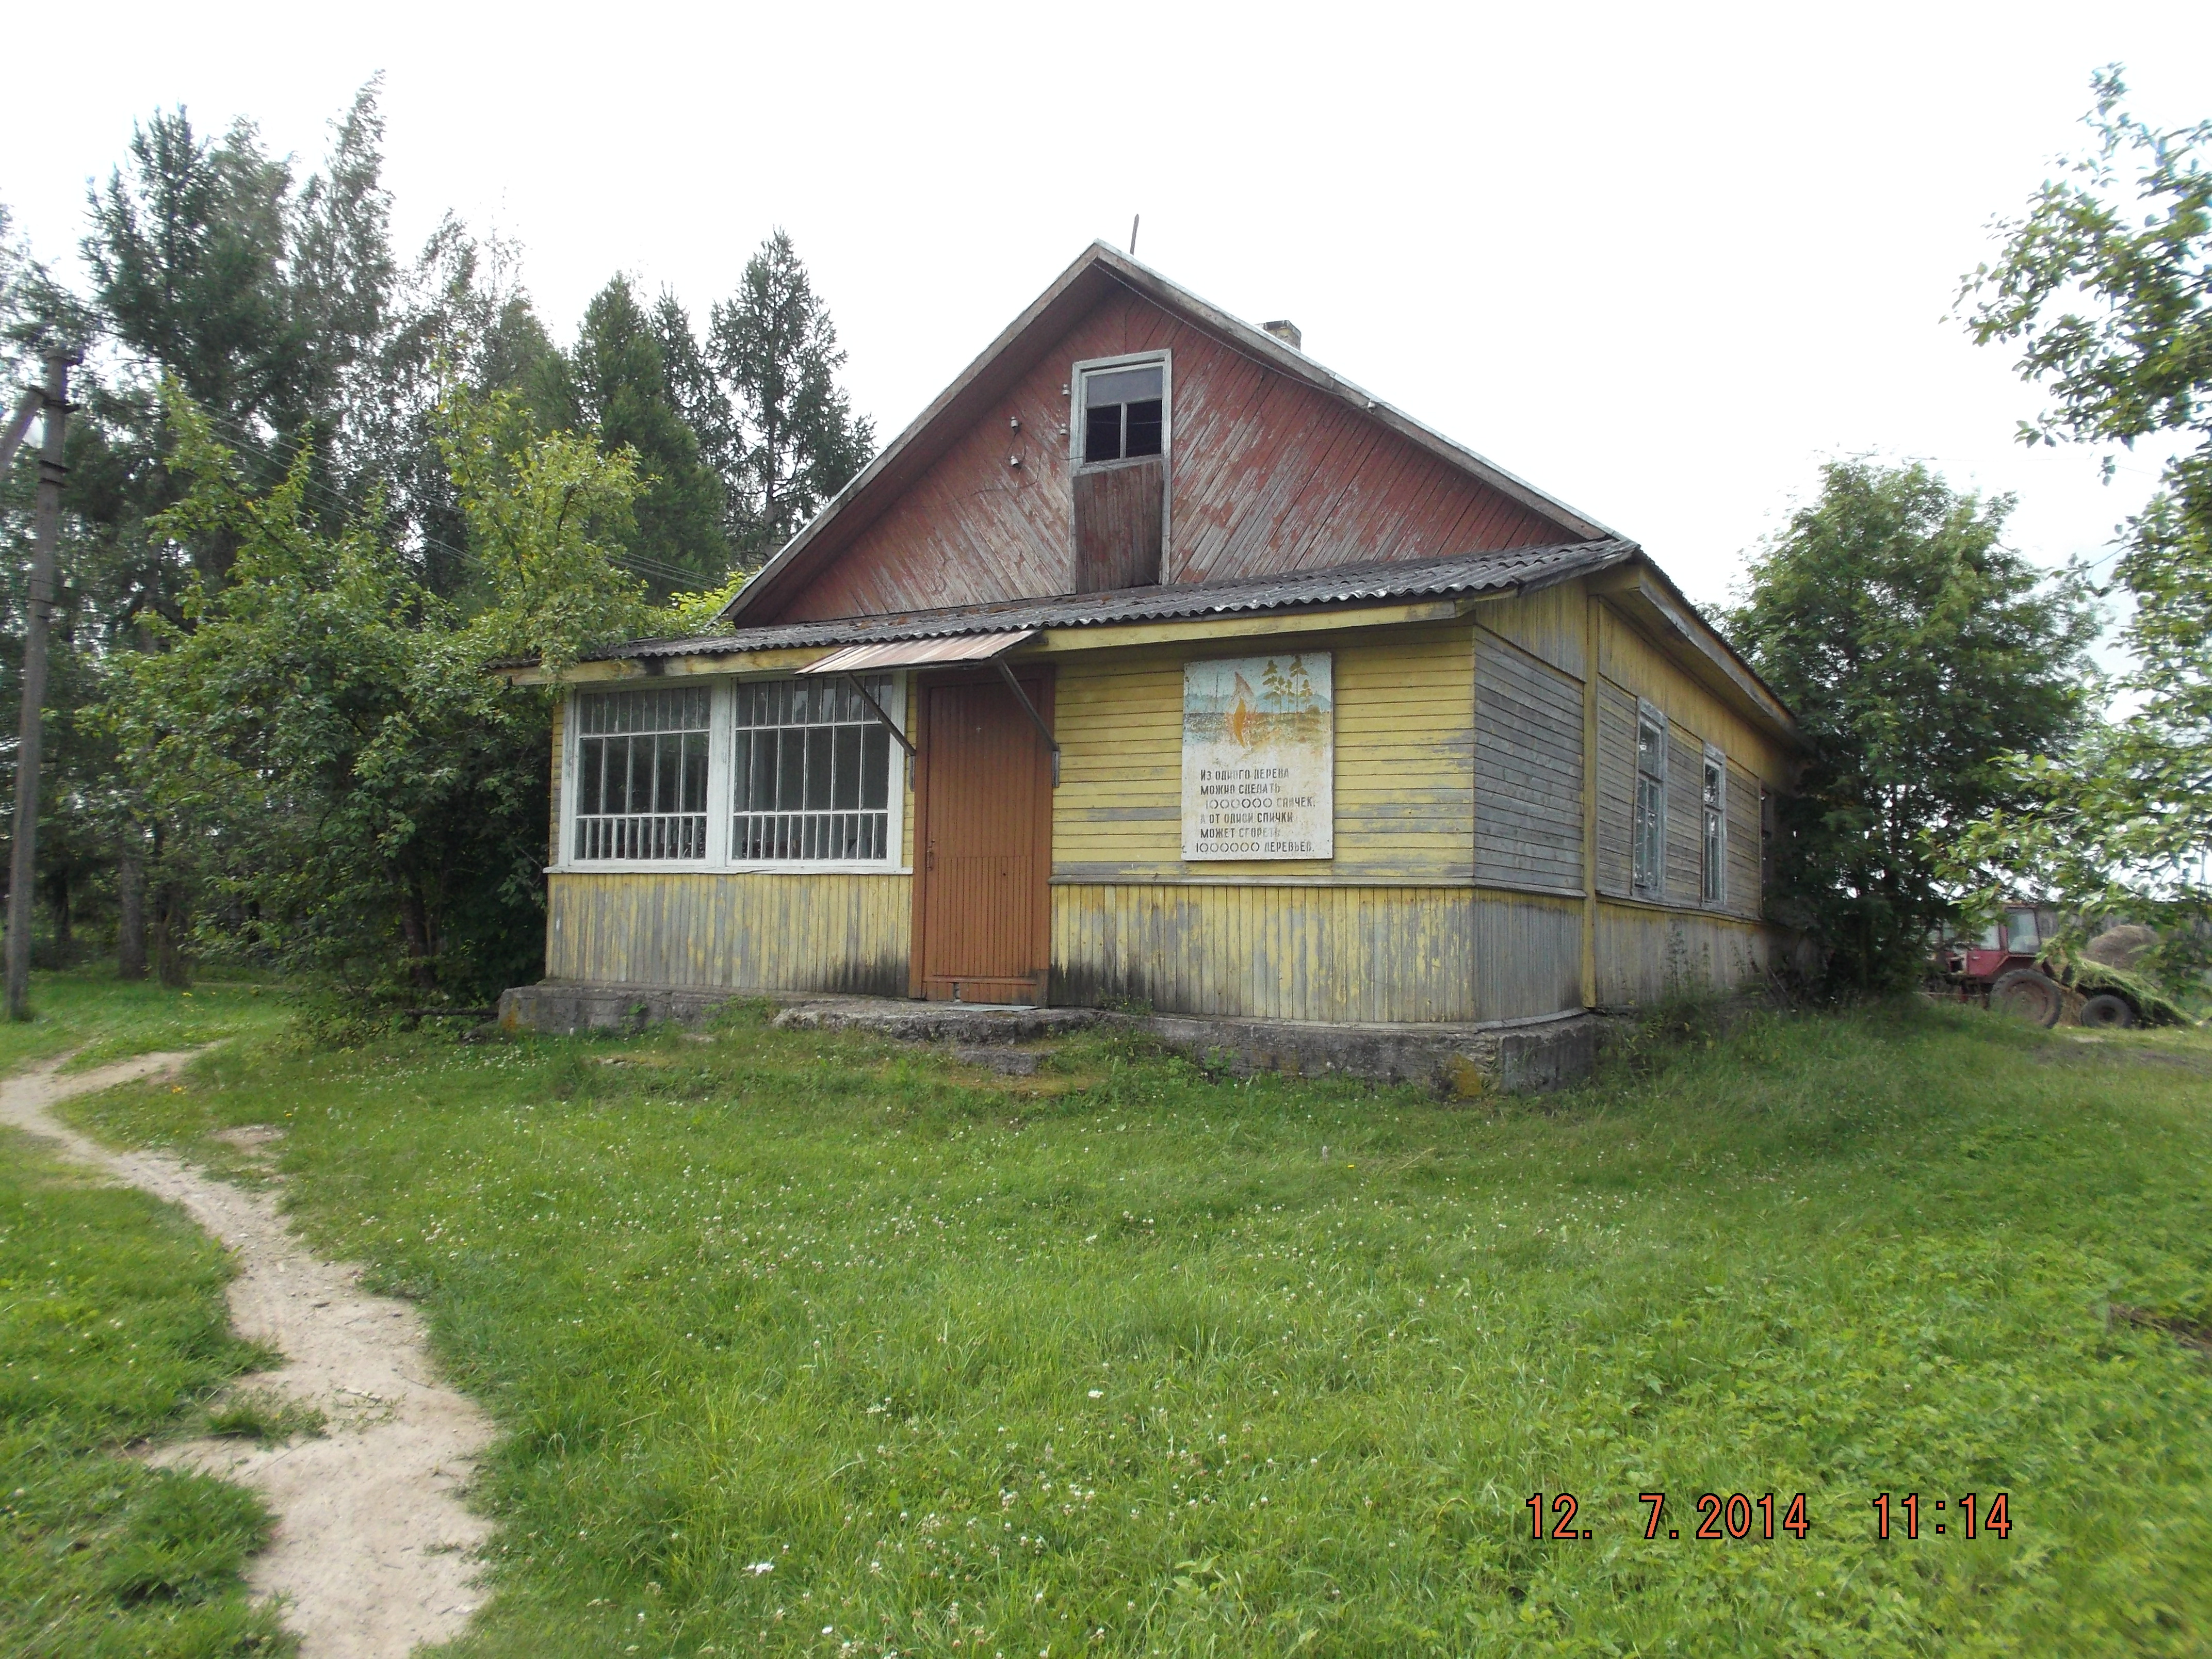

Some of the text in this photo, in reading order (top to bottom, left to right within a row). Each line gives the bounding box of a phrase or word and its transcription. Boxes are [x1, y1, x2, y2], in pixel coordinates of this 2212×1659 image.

[1215, 769, 1250, 780] ОДНОГО
[1254, 768, 1290, 780] ДЕРЕВА
[1200, 783, 1280, 795] МОЖНО СДЕЛАТЬ
[1206, 798, 1273, 809] 1000000
[1209, 814, 1220, 824] ОТ
[1257, 811, 1294, 823] СПИЧКИ
[1200, 827, 1280, 838] МОЖЕТ СГОРЕТЬ
[1196, 842, 1260, 853] 1000000
